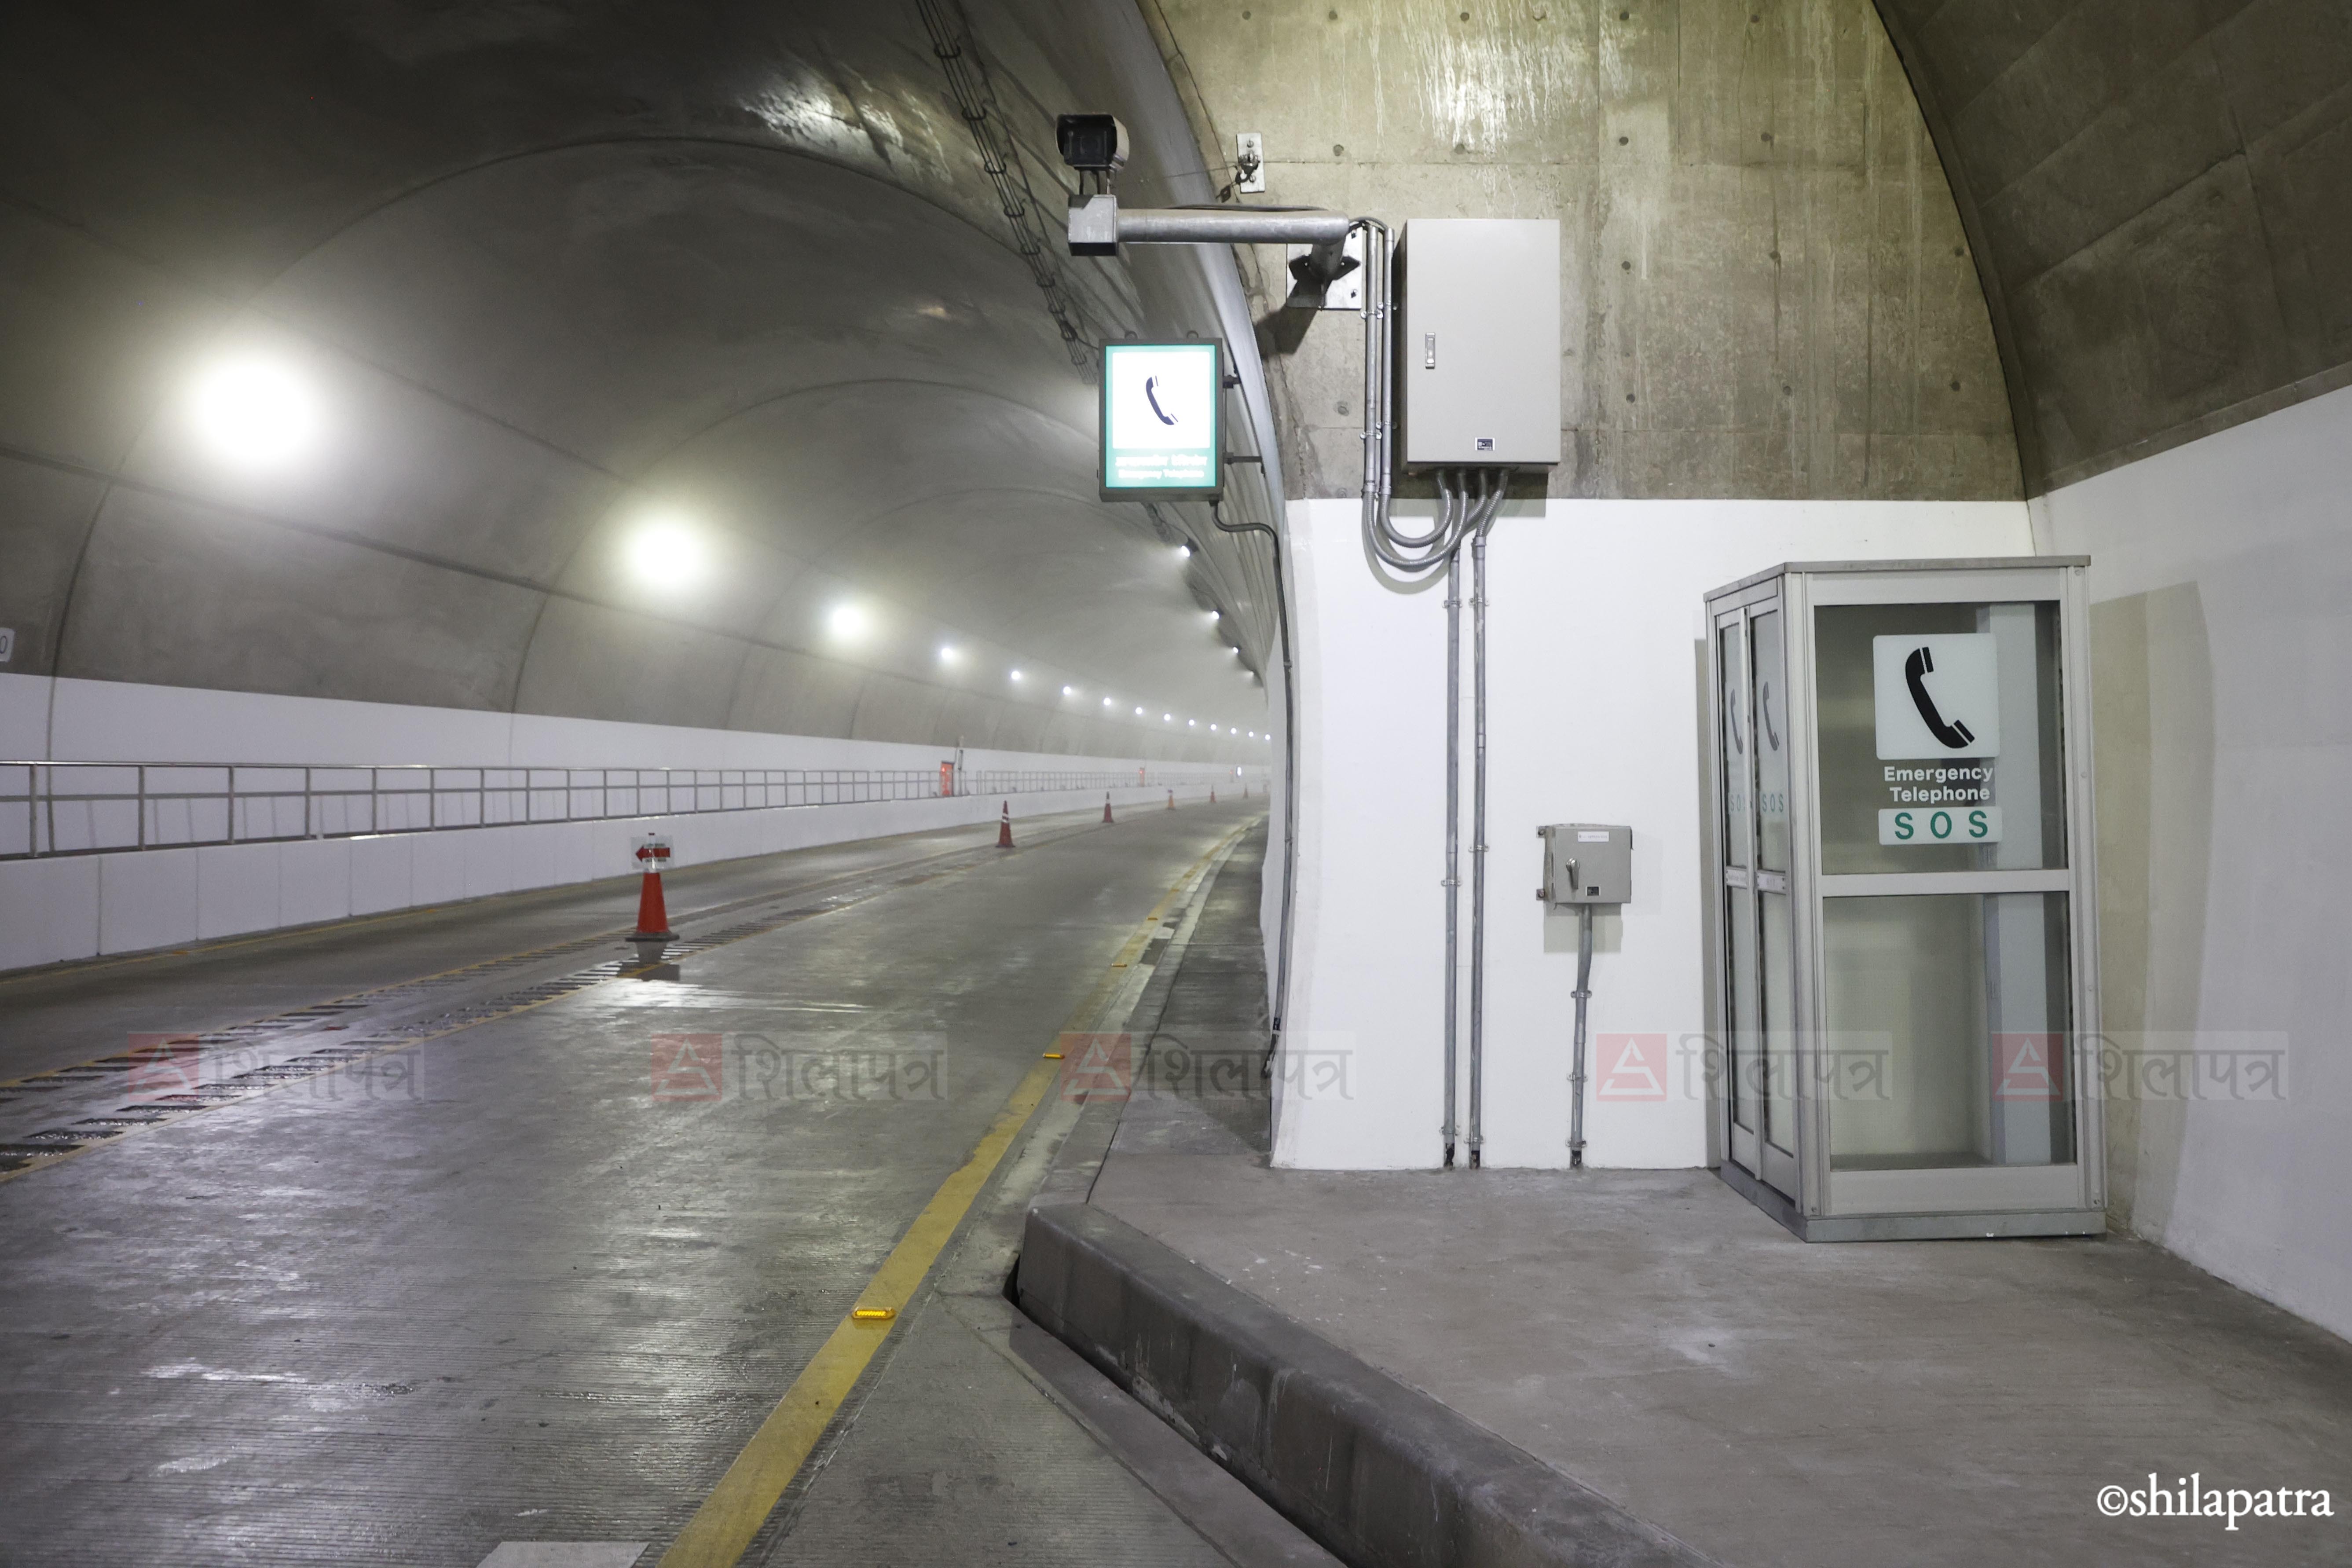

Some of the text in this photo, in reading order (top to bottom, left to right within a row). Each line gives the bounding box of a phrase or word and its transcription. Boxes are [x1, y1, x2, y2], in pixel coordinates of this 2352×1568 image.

[1884, 766, 1993, 783] Emergency
[1730, 794, 1745, 812] SO
[1762, 793, 1784, 813] SOS
[1890, 786, 1990, 803] Telephone
[1894, 810, 1988, 840] SOS
